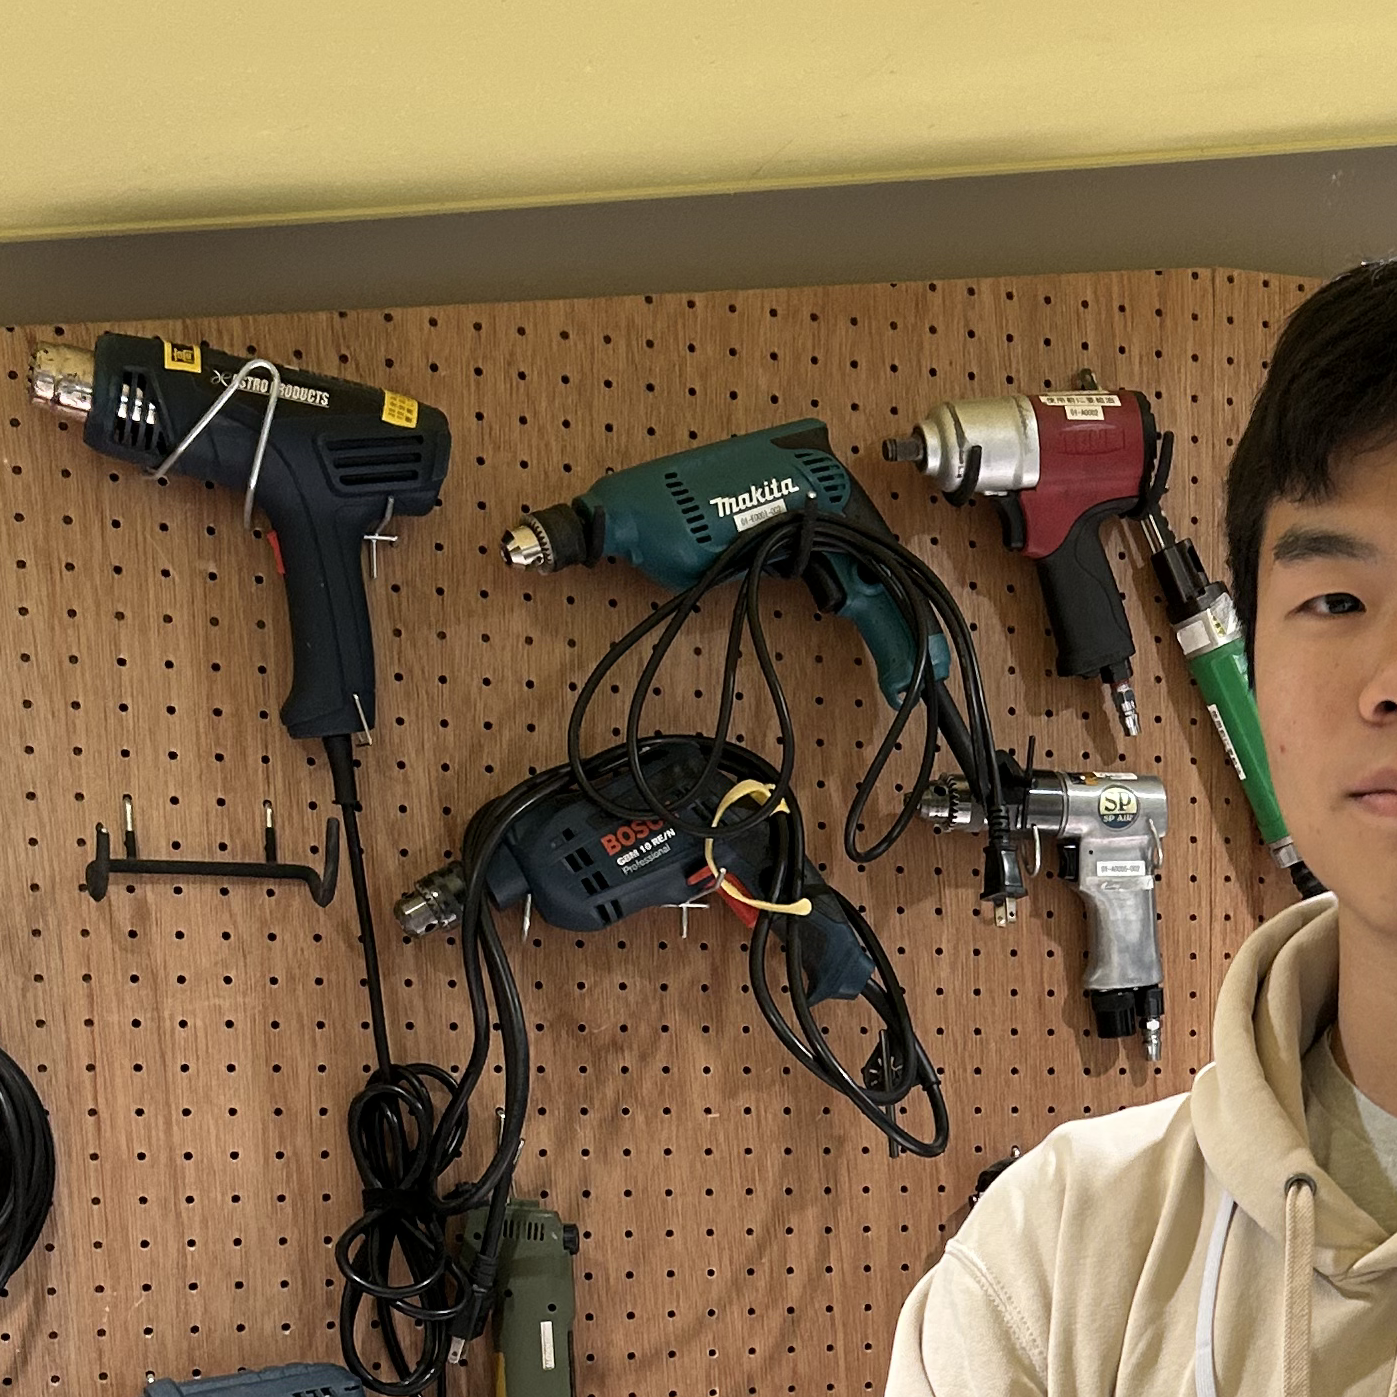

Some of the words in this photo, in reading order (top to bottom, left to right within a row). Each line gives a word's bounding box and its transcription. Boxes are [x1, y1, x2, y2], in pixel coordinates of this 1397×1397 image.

[709, 478, 800, 518] Makita
[1104, 791, 1132, 812] SP
[601, 818, 664, 857] BOSC
[621, 843, 671, 875] Professional
